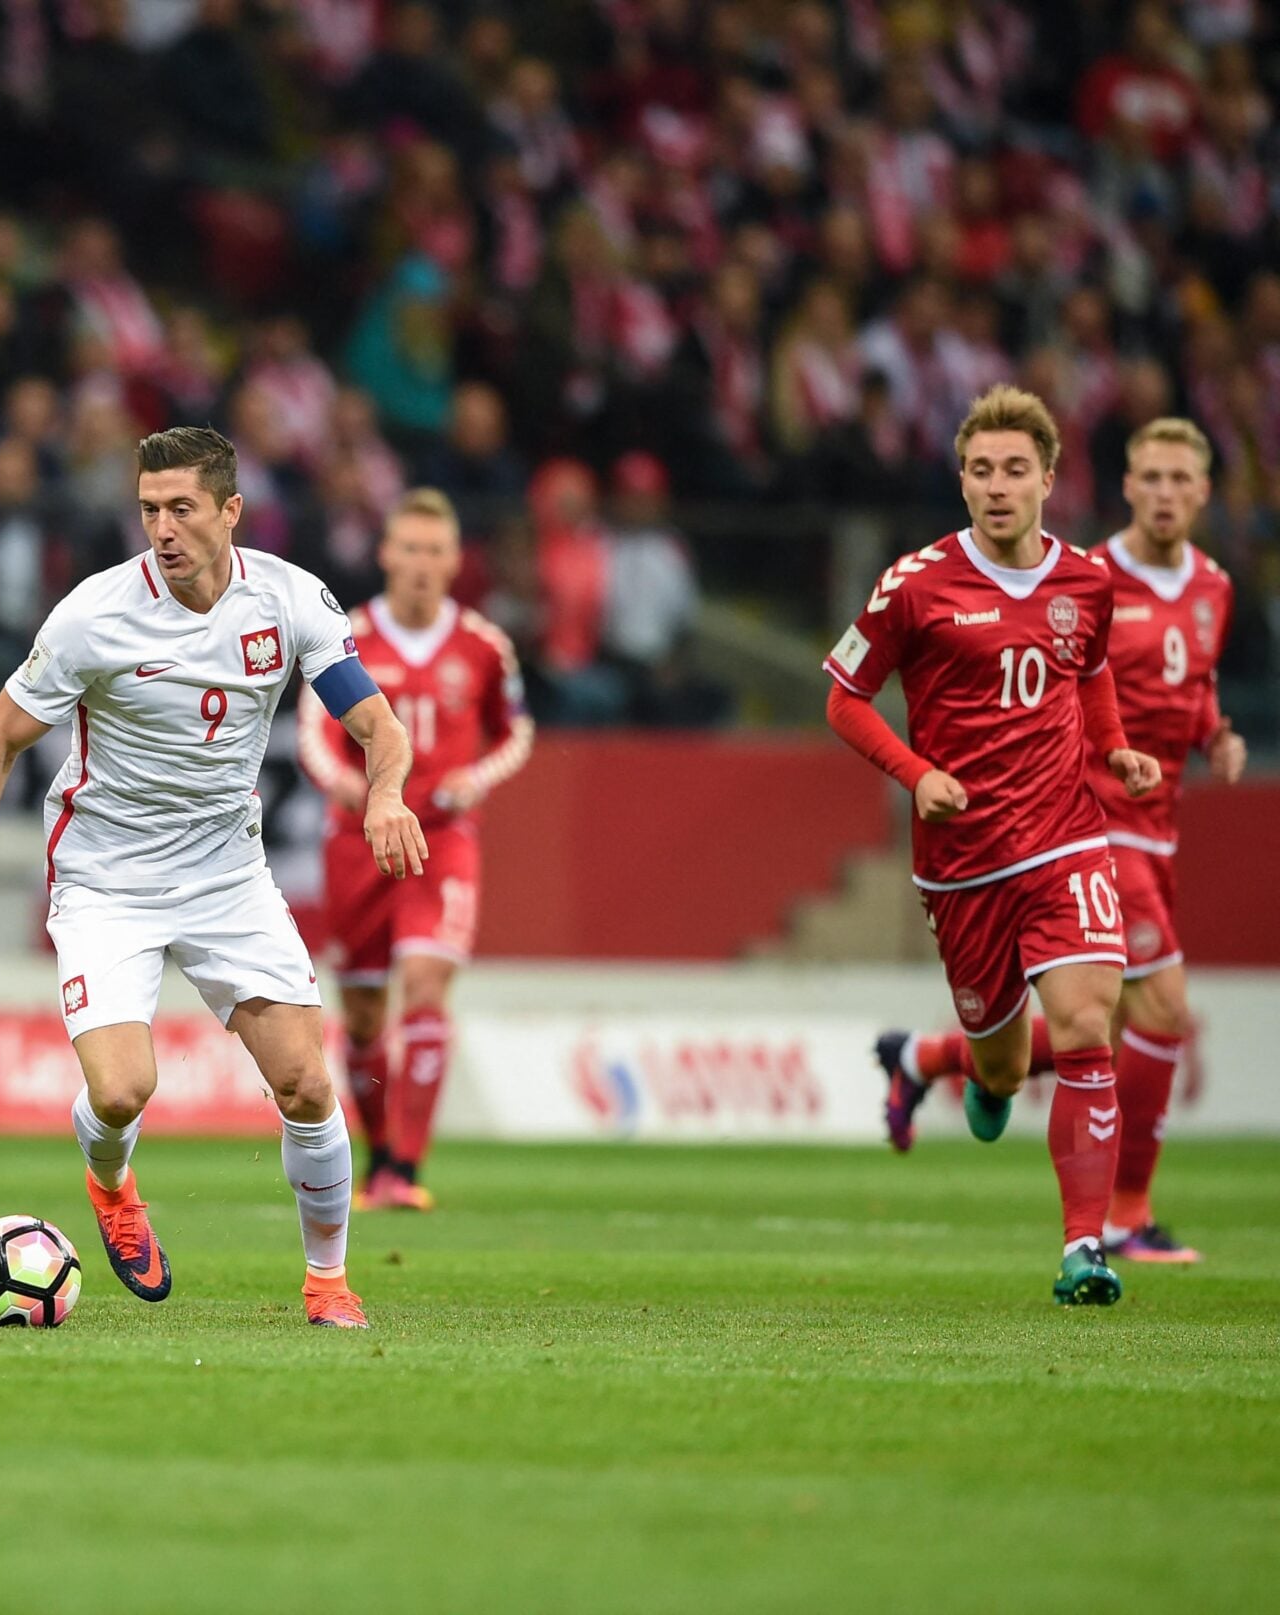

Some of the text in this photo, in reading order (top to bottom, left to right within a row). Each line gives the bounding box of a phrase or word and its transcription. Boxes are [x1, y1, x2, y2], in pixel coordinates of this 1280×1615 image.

[953, 607, 1001, 626] hummel
[1000, 647, 1046, 708] 10
[1162, 626, 1187, 686] 9
[200, 687, 228, 742] 9
[396, 696, 437, 754] 11
[1068, 871, 1116, 929] 10
